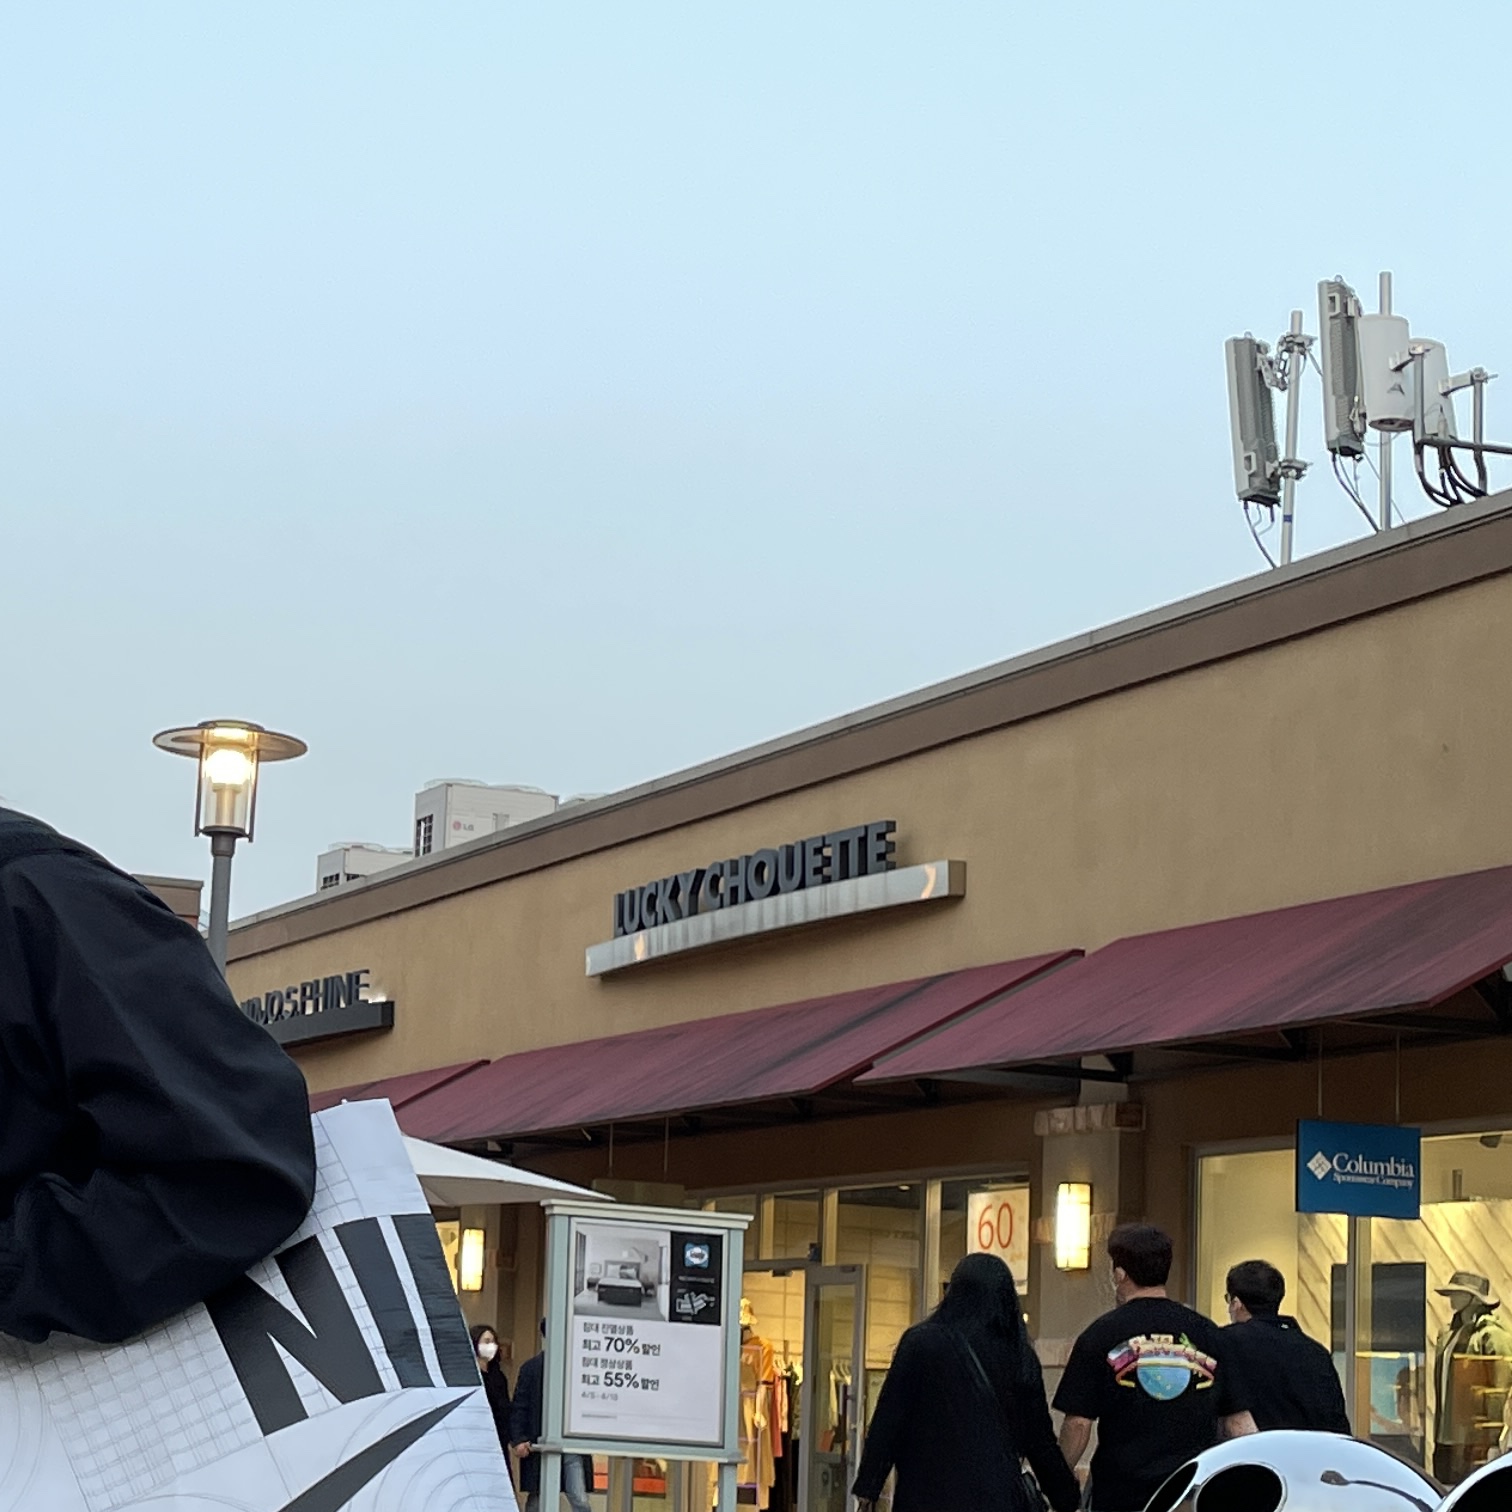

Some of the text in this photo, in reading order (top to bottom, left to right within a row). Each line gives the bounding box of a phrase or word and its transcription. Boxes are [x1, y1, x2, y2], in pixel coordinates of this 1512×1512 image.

[1332, 1152, 1415, 1178] Columbia
[978, 1203, 1013, 1250] 60
[583, 1336, 661, 1356] 최고 70% 할인
[581, 1371, 660, 1391] 최고 55% 할인
